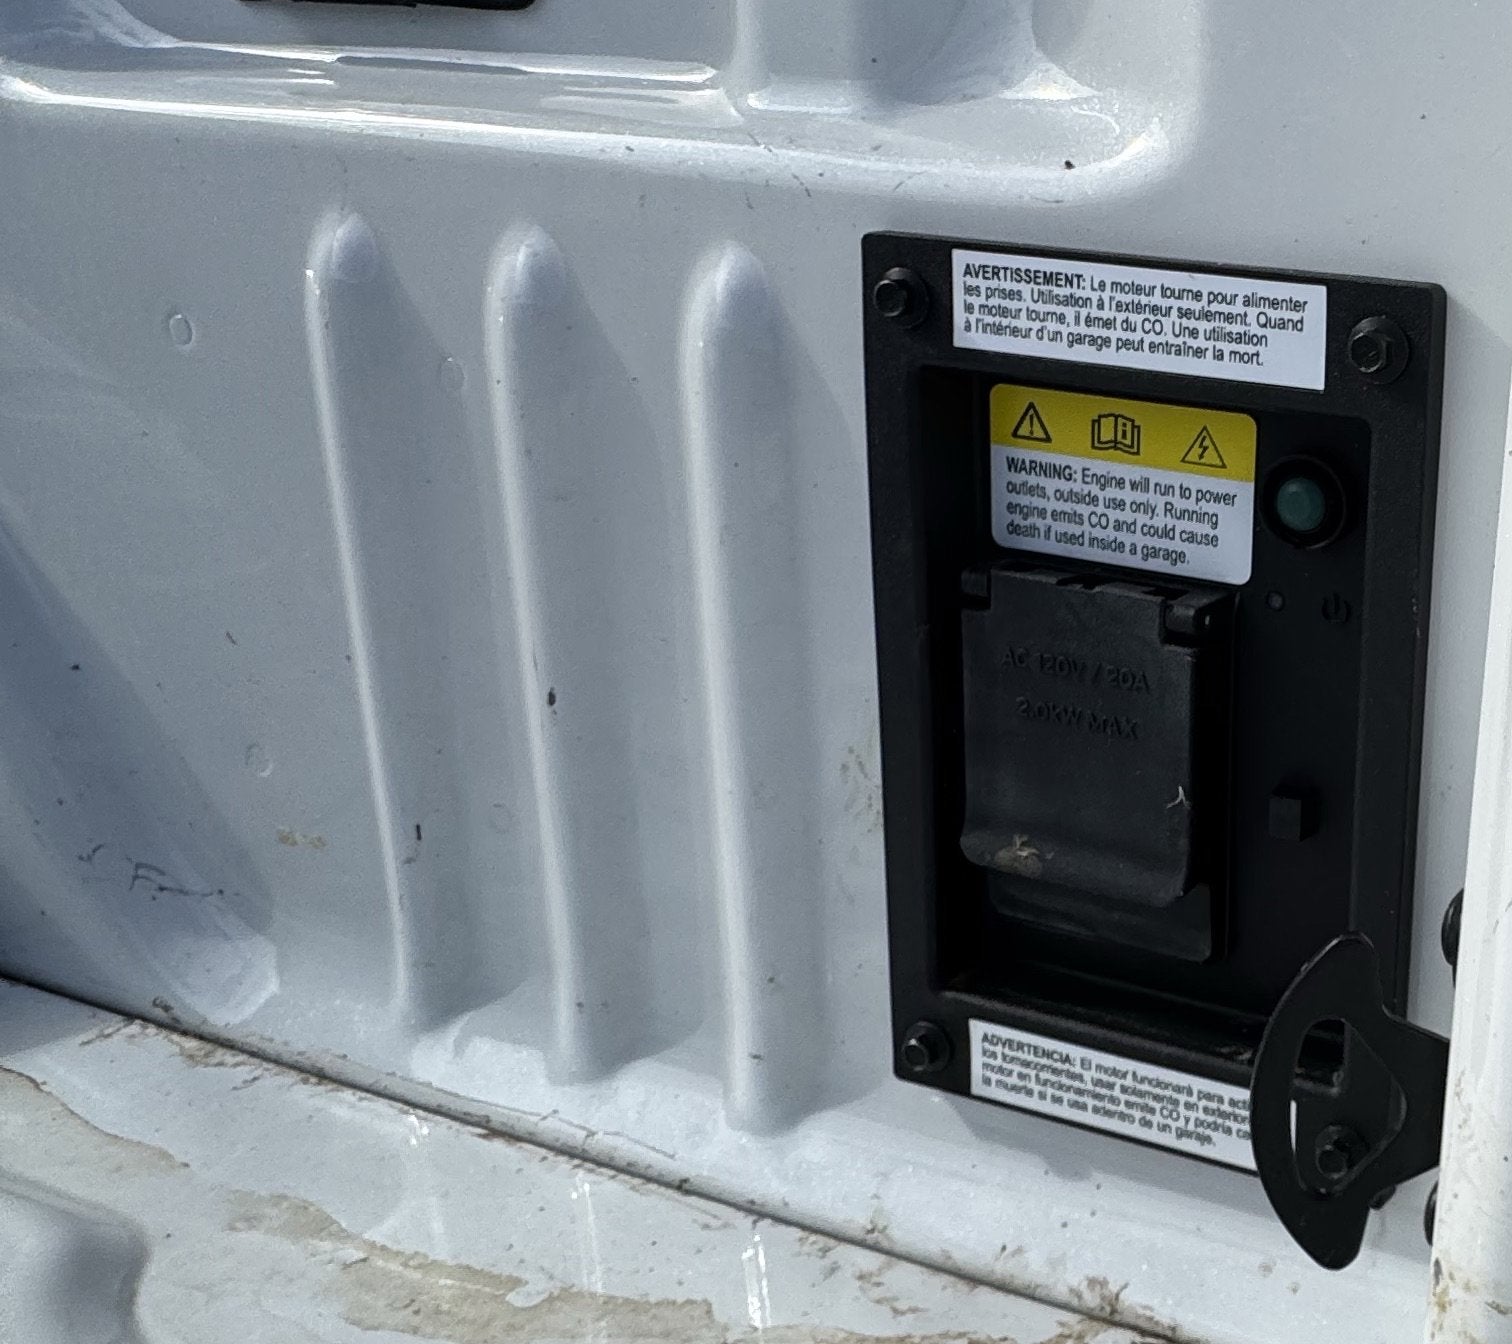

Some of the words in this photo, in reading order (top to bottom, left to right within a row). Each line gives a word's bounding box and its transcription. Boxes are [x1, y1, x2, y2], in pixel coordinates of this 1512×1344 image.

[962, 262, 1086, 291] AVERTISSEMENT:
[1090, 275, 1107, 293] Le
[1110, 280, 1157, 298] moteur
[1160, 283, 1203, 302] tourne
[1207, 290, 1239, 307] pour
[1242, 292, 1308, 313] alimenter
[963, 281, 981, 297] les
[985, 284, 1026, 302] prises.
[1031, 287, 1093, 309] Utilisation
[1096, 294, 1105, 311] à
[1109, 296, 1173, 318] l'extérieur
[1176, 306, 1251, 327] seulement.
[1256, 311, 1305, 333] Quand
[963, 299, 975, 315] le
[978, 303, 1023, 320] moteur
[1074, 310, 1081, 327] il
[1084, 312, 1117, 331] émet
[1121, 316, 1137, 333] du
[1172, 321, 1200, 340] Une
[1203, 326, 1268, 348] utilisation
[963, 317, 972, 333] à
[975, 318, 1033, 340] l'intérieur
[1036, 325, 1063, 343] d'un
[1066, 331, 1112, 352] garage
[1115, 336, 1145, 354] peut
[1148, 340, 1209, 360] entraîner
[1212, 344, 1225, 361] la
[1228, 349, 1264, 367] mort.
[1005, 455, 1078, 483] WARNING:
[1081, 467, 1126, 492] Engine
[1129, 474, 1150, 494] will
[1154, 482, 1175, 498] run
[1179, 482, 1192, 500] to
[1195, 488, 1238, 507] power
[1006, 479, 1051, 502] outlets,
[1053, 486, 1100, 508] outside
[1103, 495, 1126, 512] use
[1129, 499, 1160, 521] only.
[1163, 501, 1219, 531] Running
[1006, 500, 1047, 522] engine
[1050, 506, 1085, 526] emits
[1088, 510, 1110, 531] CO
[1112, 517, 1137, 535] and
[1140, 523, 1176, 542] could
[1179, 528, 1219, 548] cause
[1006, 519, 1041, 539] death
[1043, 524, 1053, 541] if
[1054, 529, 1085, 547] used
[1088, 531, 1126, 554] inside
[1128, 542, 1138, 557] a
[1140, 543, 1190, 567] garage.
[1000, 644, 1030, 669] AC
[1033, 651, 1087, 677] 120V
[1104, 664, 1151, 695] 20A
[1085, 709, 1140, 741] MAX
[981, 1031, 1077, 1068] ADVERTENCIA:
[1197, 1088, 1225, 1106] para
[1138, 1115, 1154, 1130] de
[1156, 1121, 1172, 1134] un
[1159, 1105, 1181, 1123] CO
[1183, 1099, 1199, 1113] en
